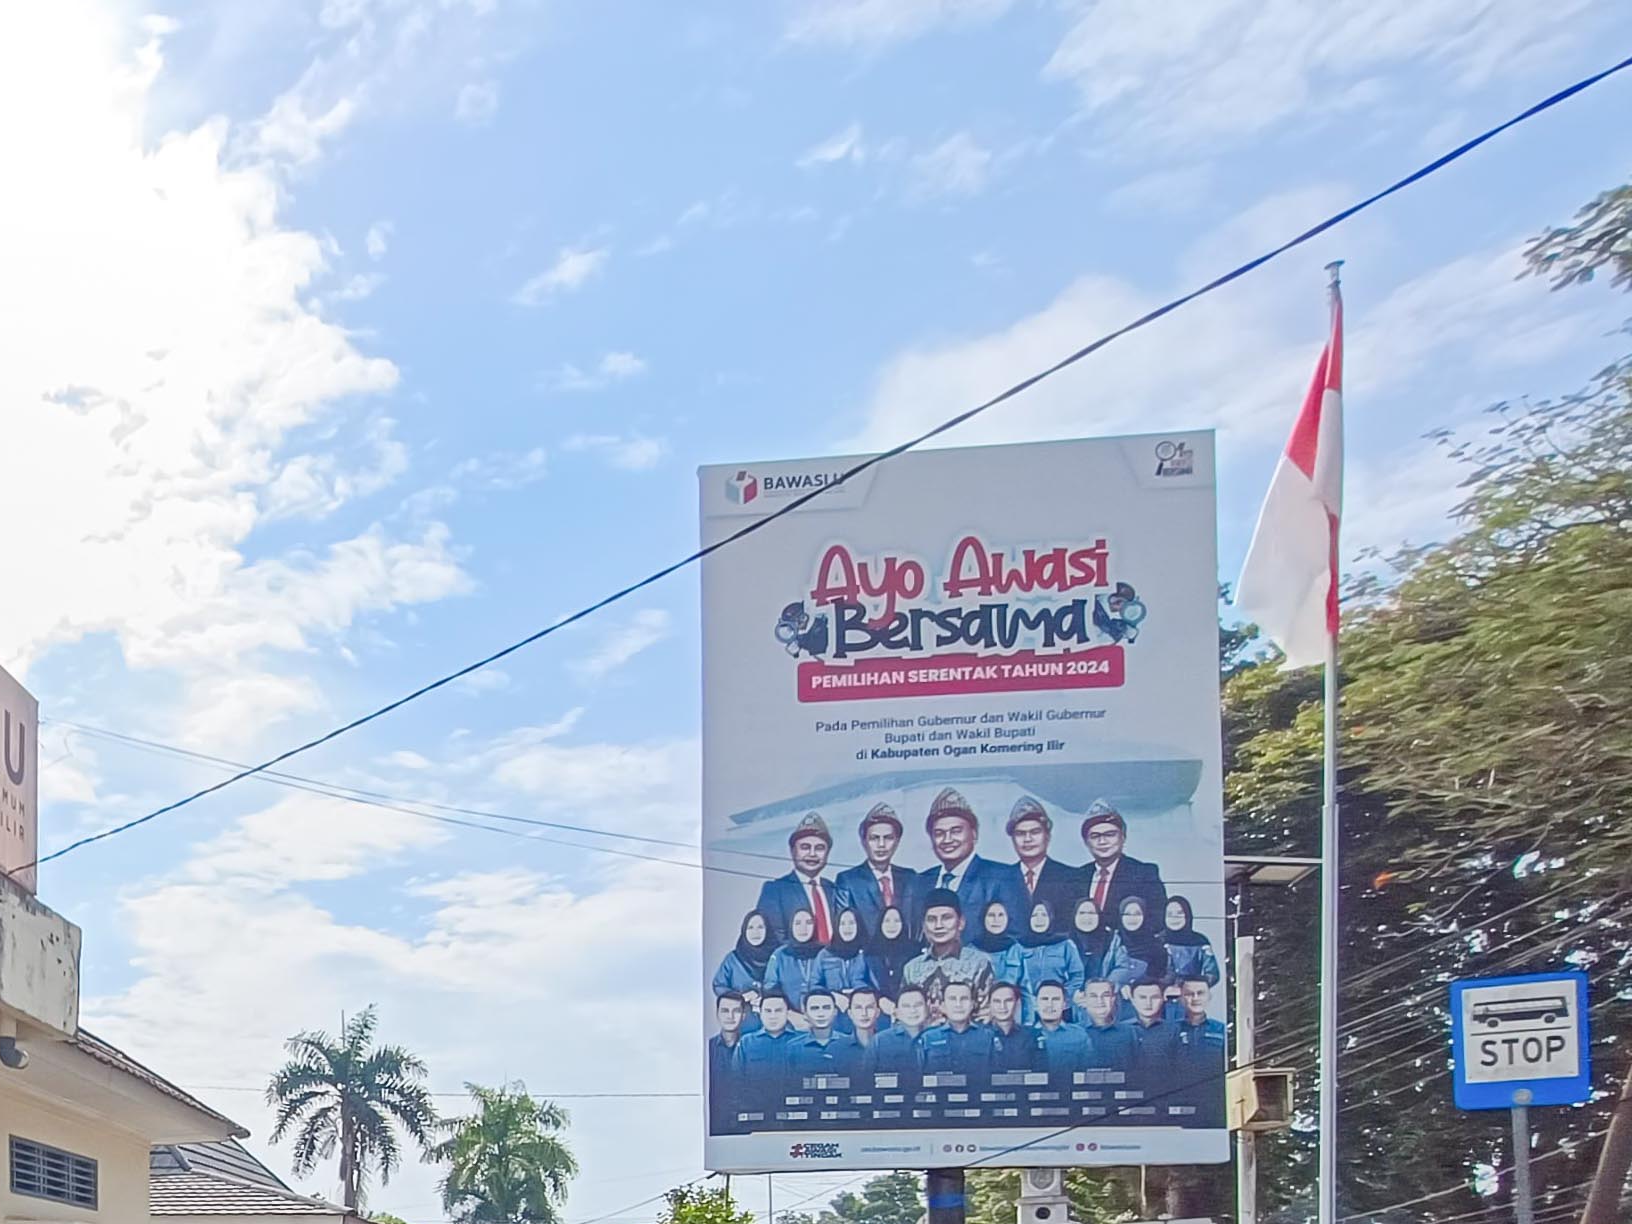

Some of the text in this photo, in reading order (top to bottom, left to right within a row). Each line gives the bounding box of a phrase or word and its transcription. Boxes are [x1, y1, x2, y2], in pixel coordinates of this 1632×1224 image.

[810, 536, 1109, 631] Ayo Awasi
[831, 596, 1087, 658] Bersama
[811, 660, 1110, 689] PEMILIHAN SERENTAK TAHUN 2024
[816, 708, 1107, 732] Pada Pemilihan Gubernur dan Wakil Gubernur
[856, 740, 1066, 761] di Kabupaten Ogan Komering Ilir
[885, 726, 1036, 745] Bupati dan Wakil Bupati
[0, 811, 25, 842] ILIR
[1480, 1036, 1566, 1067] STOP
